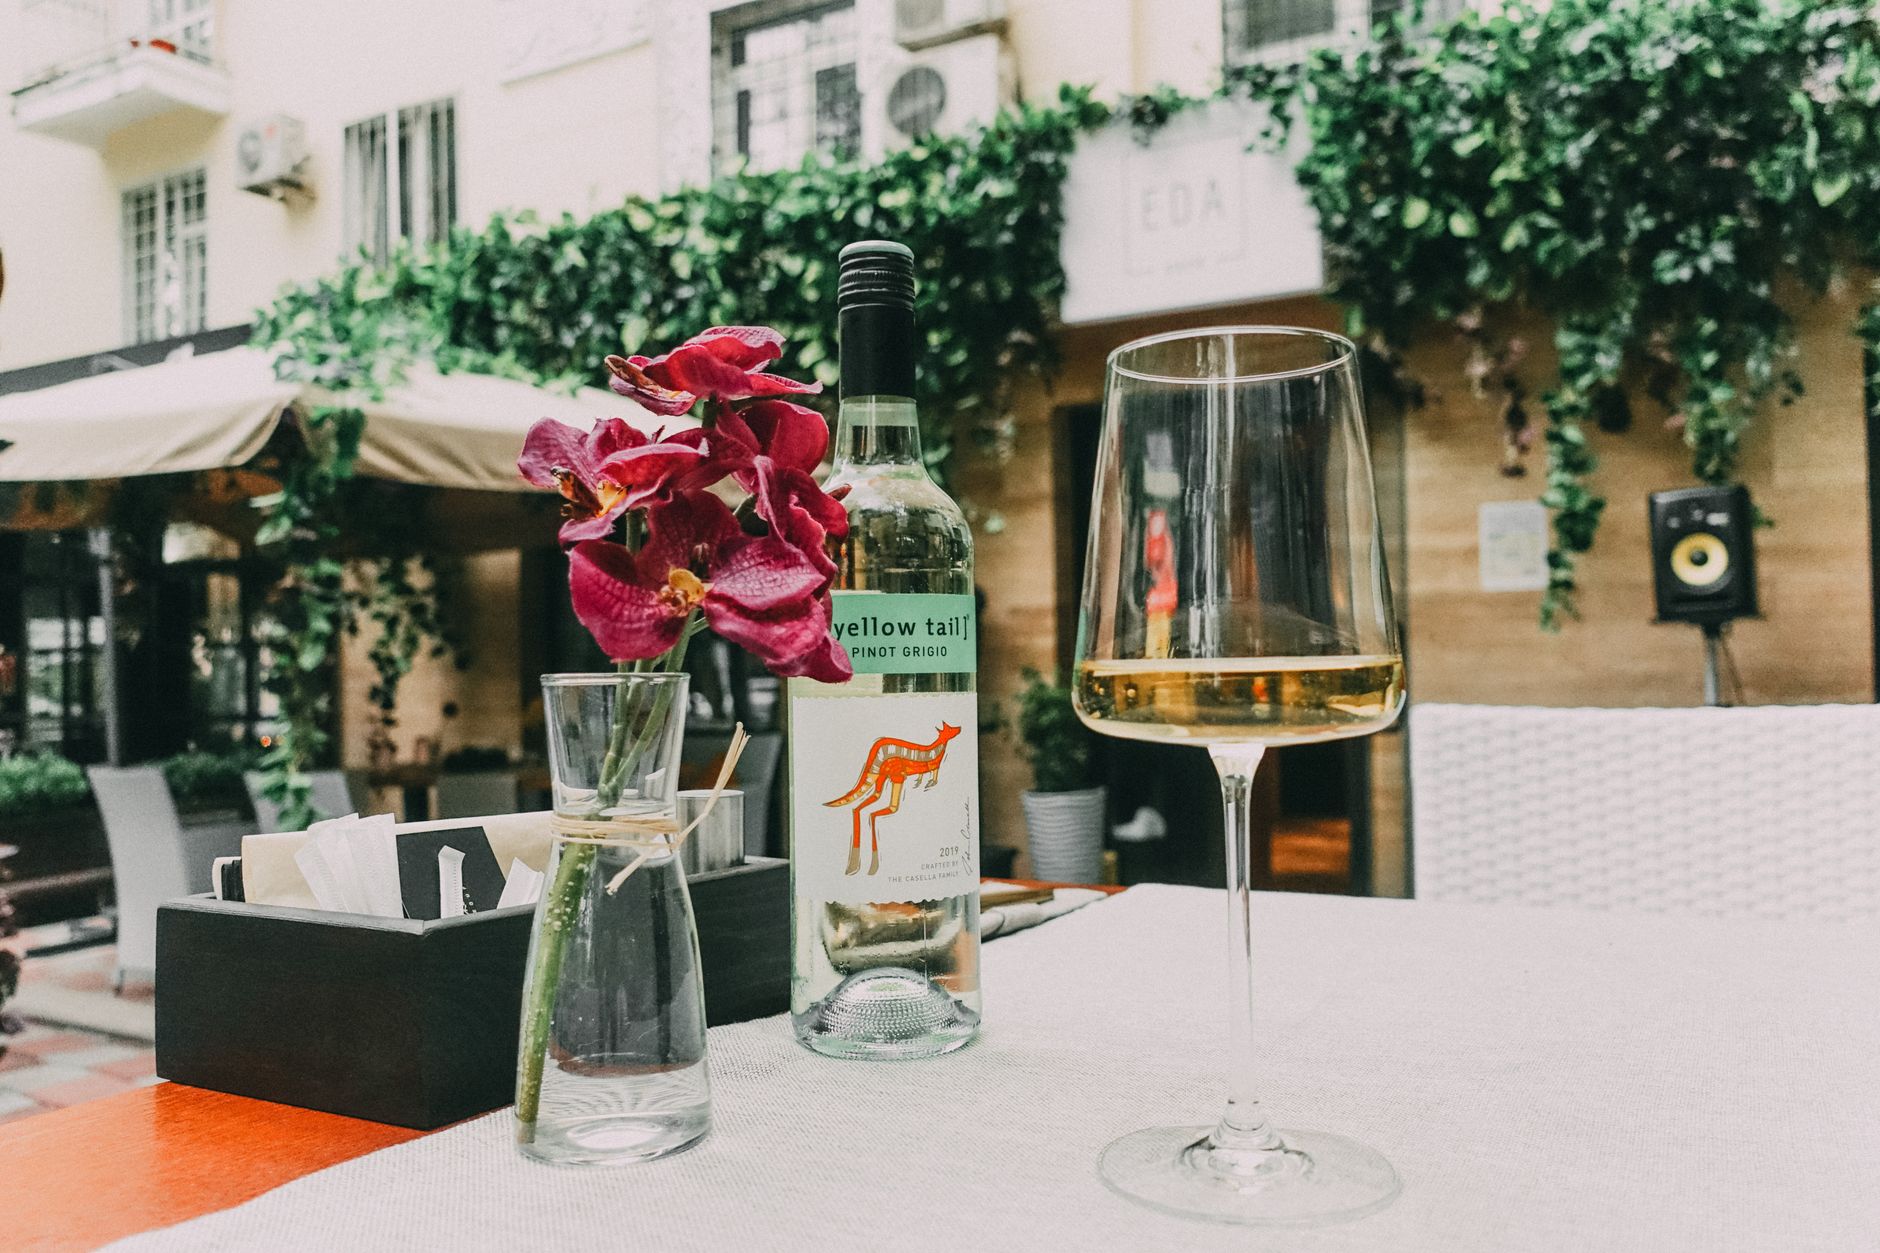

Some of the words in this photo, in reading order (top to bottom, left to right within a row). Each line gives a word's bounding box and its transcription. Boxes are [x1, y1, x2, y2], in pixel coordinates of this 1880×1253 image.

[1140, 176, 1226, 232] EDA
[852, 646, 896, 658] PINOT
[903, 646, 947, 657] GRIGIO
[940, 846, 959, 857] 2019
[921, 862, 950, 870] CRAFTED
[905, 874, 936, 882] CASELLA
[939, 871, 959, 879] FAMILY
